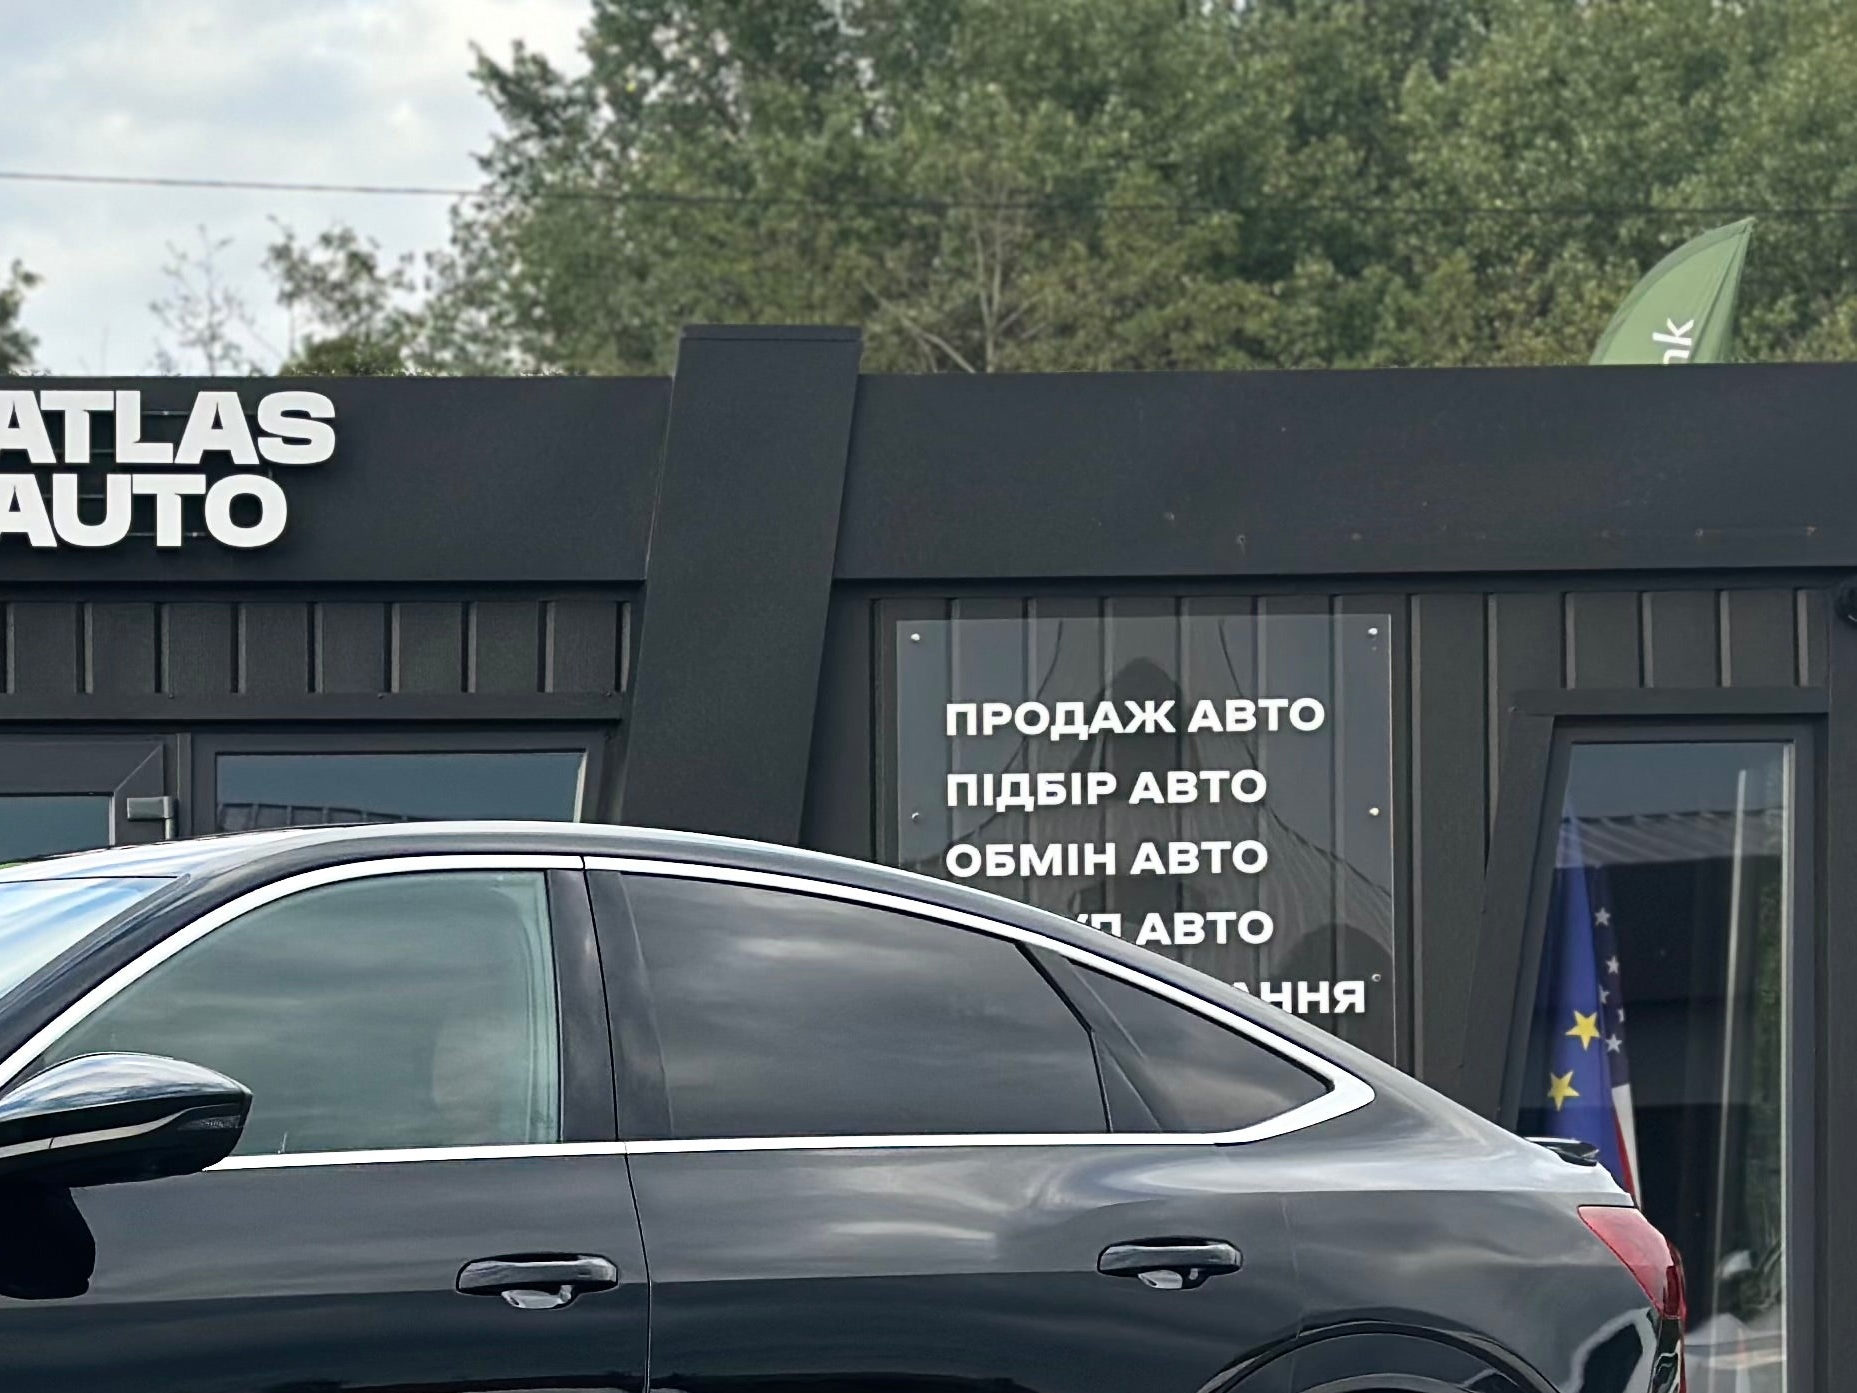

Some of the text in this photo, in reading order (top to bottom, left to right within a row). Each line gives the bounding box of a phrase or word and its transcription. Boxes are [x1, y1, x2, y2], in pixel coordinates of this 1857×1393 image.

[946, 698, 1325, 741] ПРОДАЖ АВТО
[946, 769, 1267, 812] ПІДБІР АВТО
[946, 840, 1269, 878] ОБМІН АВТО
[1136, 911, 1274, 945] АВТО
